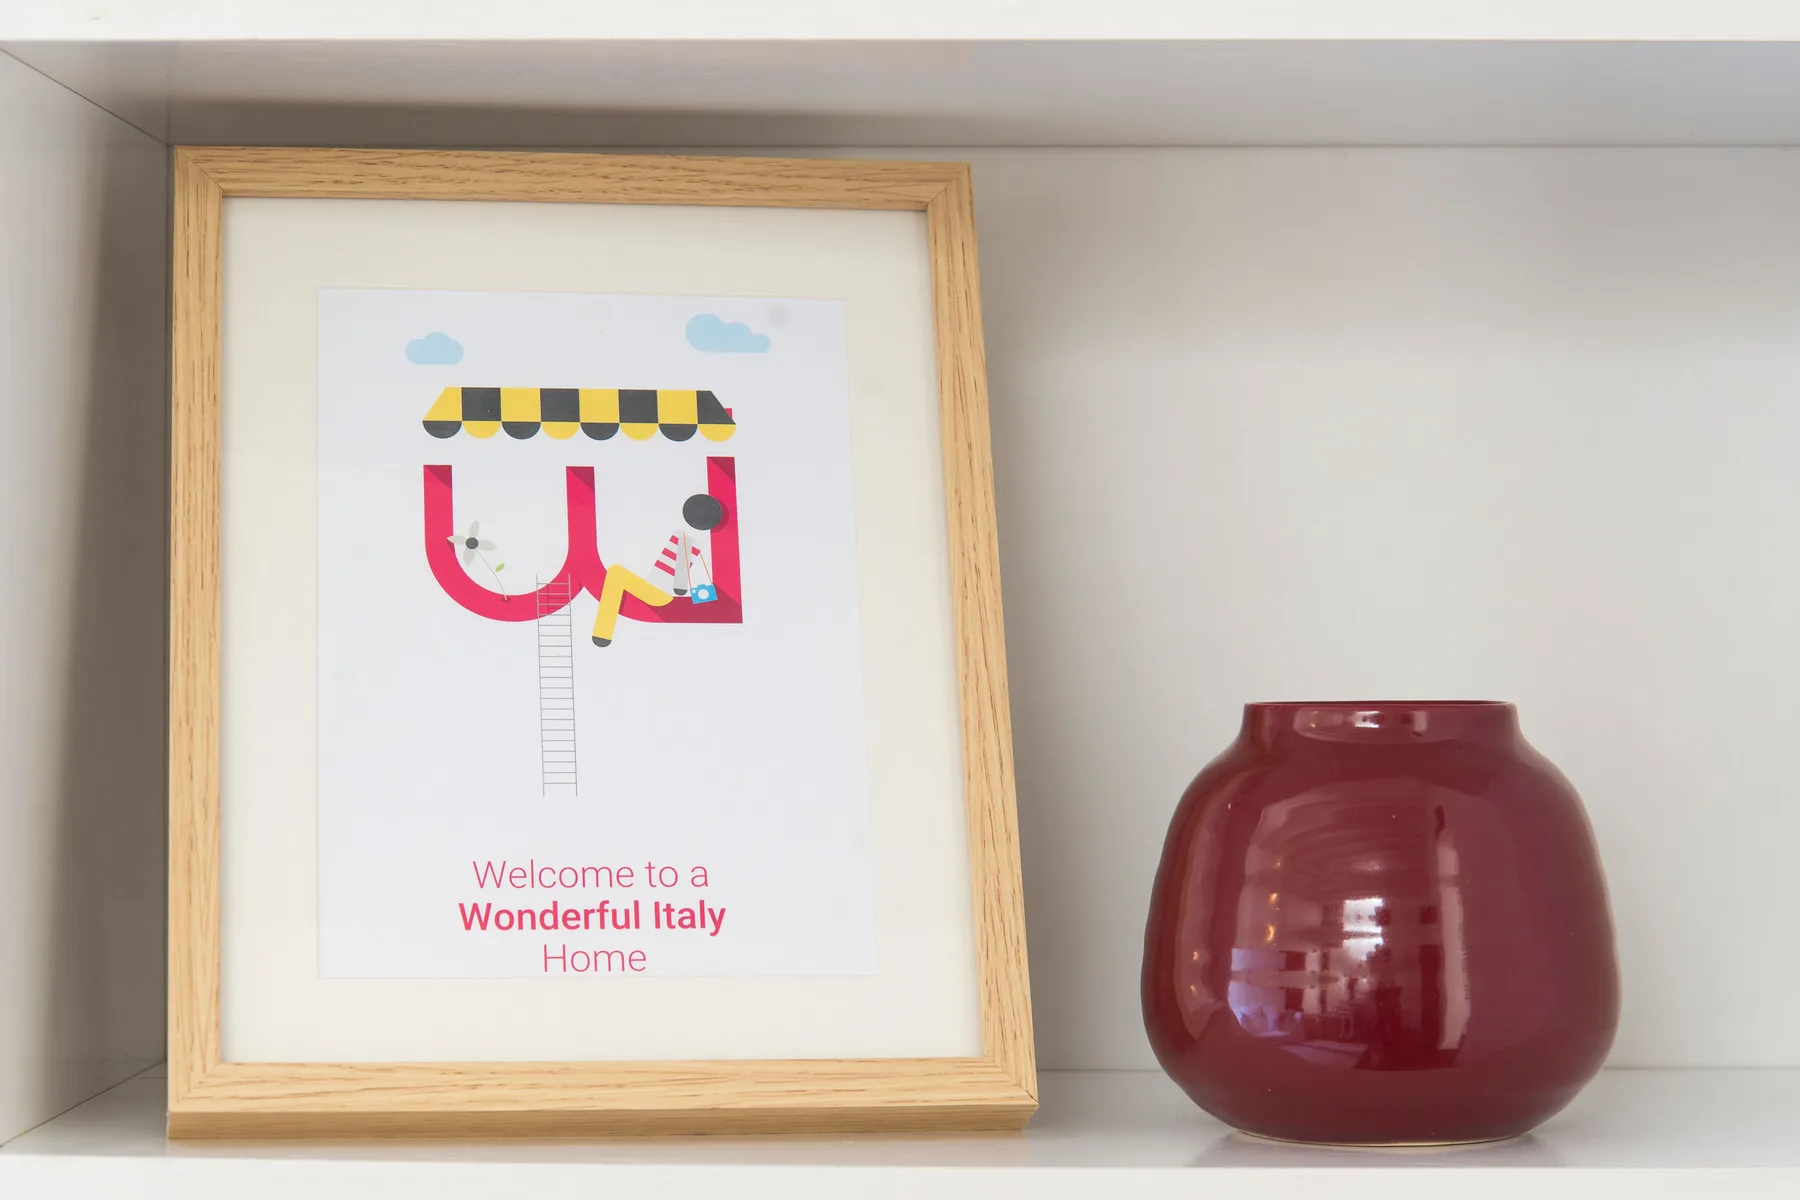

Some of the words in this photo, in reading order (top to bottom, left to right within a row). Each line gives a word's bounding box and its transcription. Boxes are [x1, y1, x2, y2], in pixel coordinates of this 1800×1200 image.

[472, 859, 635, 889] Welcome
[644, 861, 679, 888] to
[690, 865, 709, 888] a
[458, 899, 641, 931] Wonderful
[653, 898, 727, 937] Italy
[543, 943, 647, 973] Home
